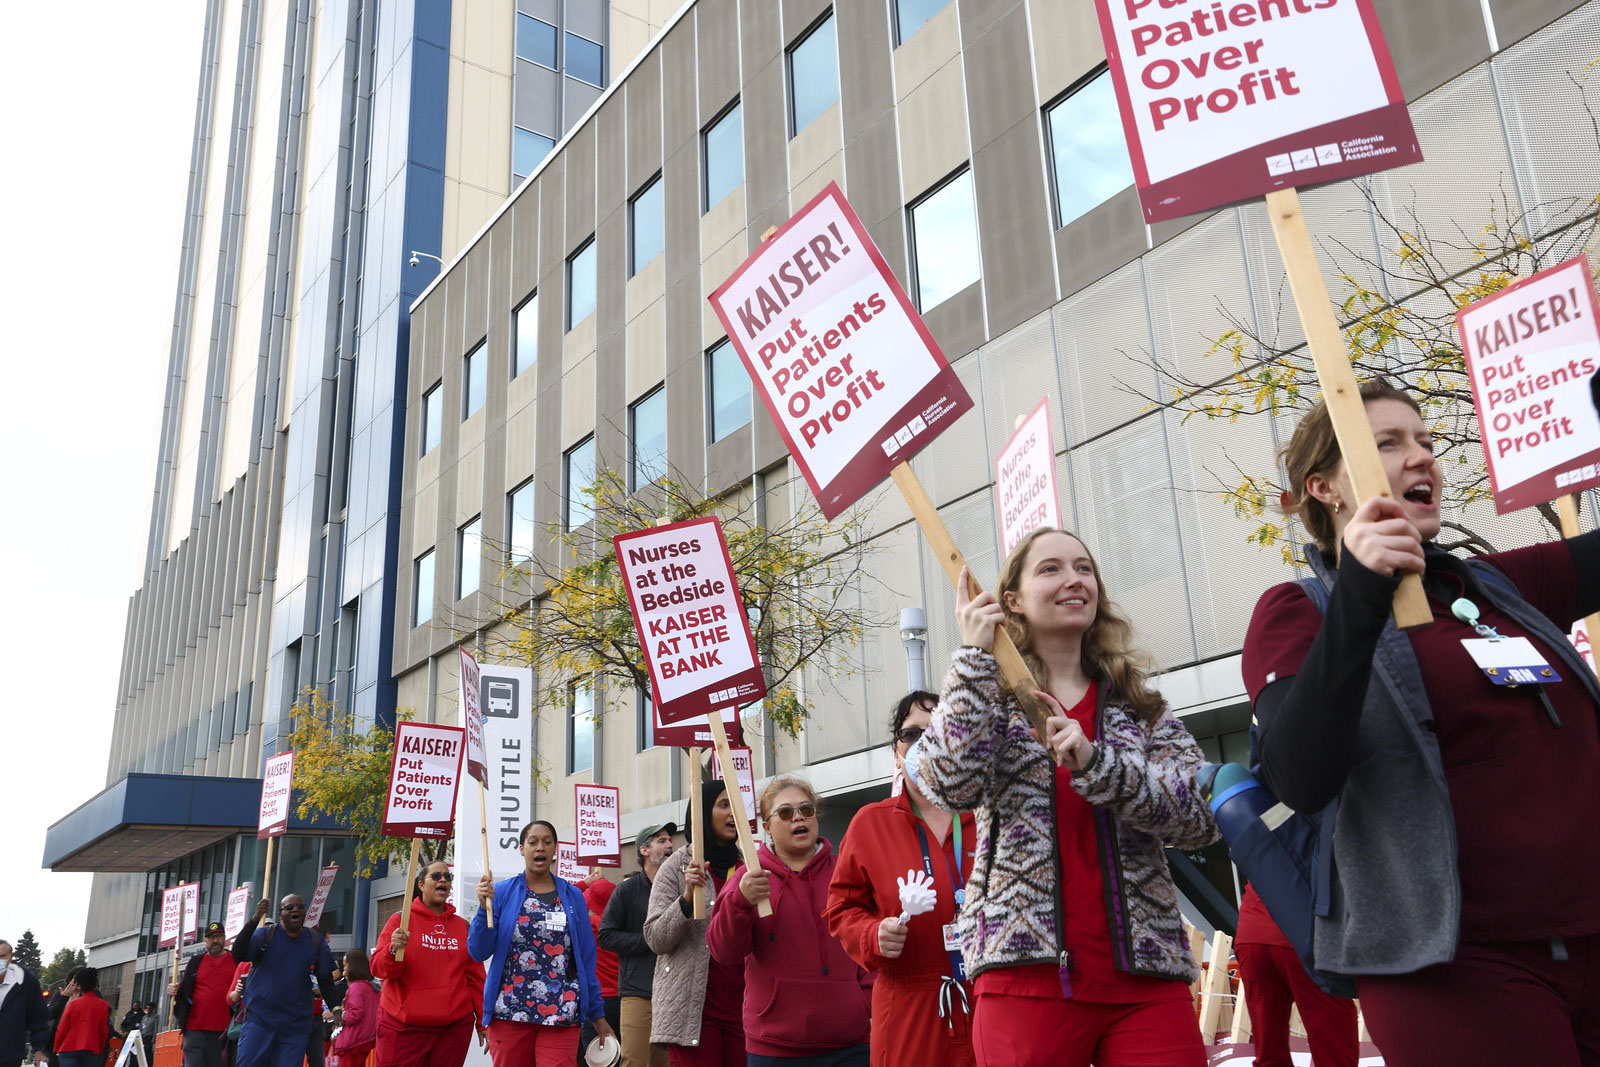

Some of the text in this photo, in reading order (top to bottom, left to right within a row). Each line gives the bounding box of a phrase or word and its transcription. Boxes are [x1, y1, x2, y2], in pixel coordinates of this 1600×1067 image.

[1141, 38, 1264, 90] Over
[1149, 66, 1300, 132] Profit
[1341, 135, 1384, 148] California
[1343, 144, 1374, 155] Nurses
[1345, 145, 1397, 161] Association
[736, 221, 851, 340] KAISER!
[1475, 287, 1582, 359] KAISER!
[757, 316, 808, 371] Put
[771, 291, 887, 396] Patients
[1482, 354, 1525, 387] Put
[787, 353, 854, 419] Over
[1488, 358, 1595, 411] Patients
[799, 368, 885, 449] Profit
[922, 396, 947, 417] California
[925, 406, 943, 421] Nurses
[928, 401, 957, 426] Association
[1493, 397, 1554, 432] Over
[1497, 415, 1574, 458] Profit
[1001, 432, 1037, 483] Nurses
[1003, 463, 1032, 507] at the
[1005, 473, 1047, 530] Bedside
[628, 538, 701, 567] Nurses
[635, 563, 696, 589] at the
[641, 579, 725, 612] Bedside
[648, 604, 727, 637] KAISER
[656, 625, 730, 658] AT THE
[659, 649, 723, 680] BANK
[1508, 669, 1538, 682] RN
[402, 735, 458, 757] KAISER!
[267, 762, 290, 779] KAISER!
[399, 757, 424, 770] Put
[265, 782, 274, 790] Put
[397, 771, 452, 786] Patients
[264, 788, 287, 799] Patients
[395, 784, 429, 797] Over
[500, 738, 520, 850] SHUTTLE
[580, 794, 615, 808] KAISER!
[262, 808, 278, 818] Profit
[263, 800, 276, 809] Over
[393, 797, 433, 811] Profit
[581, 810, 596, 818] Put
[580, 819, 615, 829] Patients
[581, 828, 602, 837] Over
[581, 838, 607, 847] Profit
[561, 850, 576, 861] KAIS
[164, 924, 179, 932] Prof
[422, 933, 458, 945] iNurse
